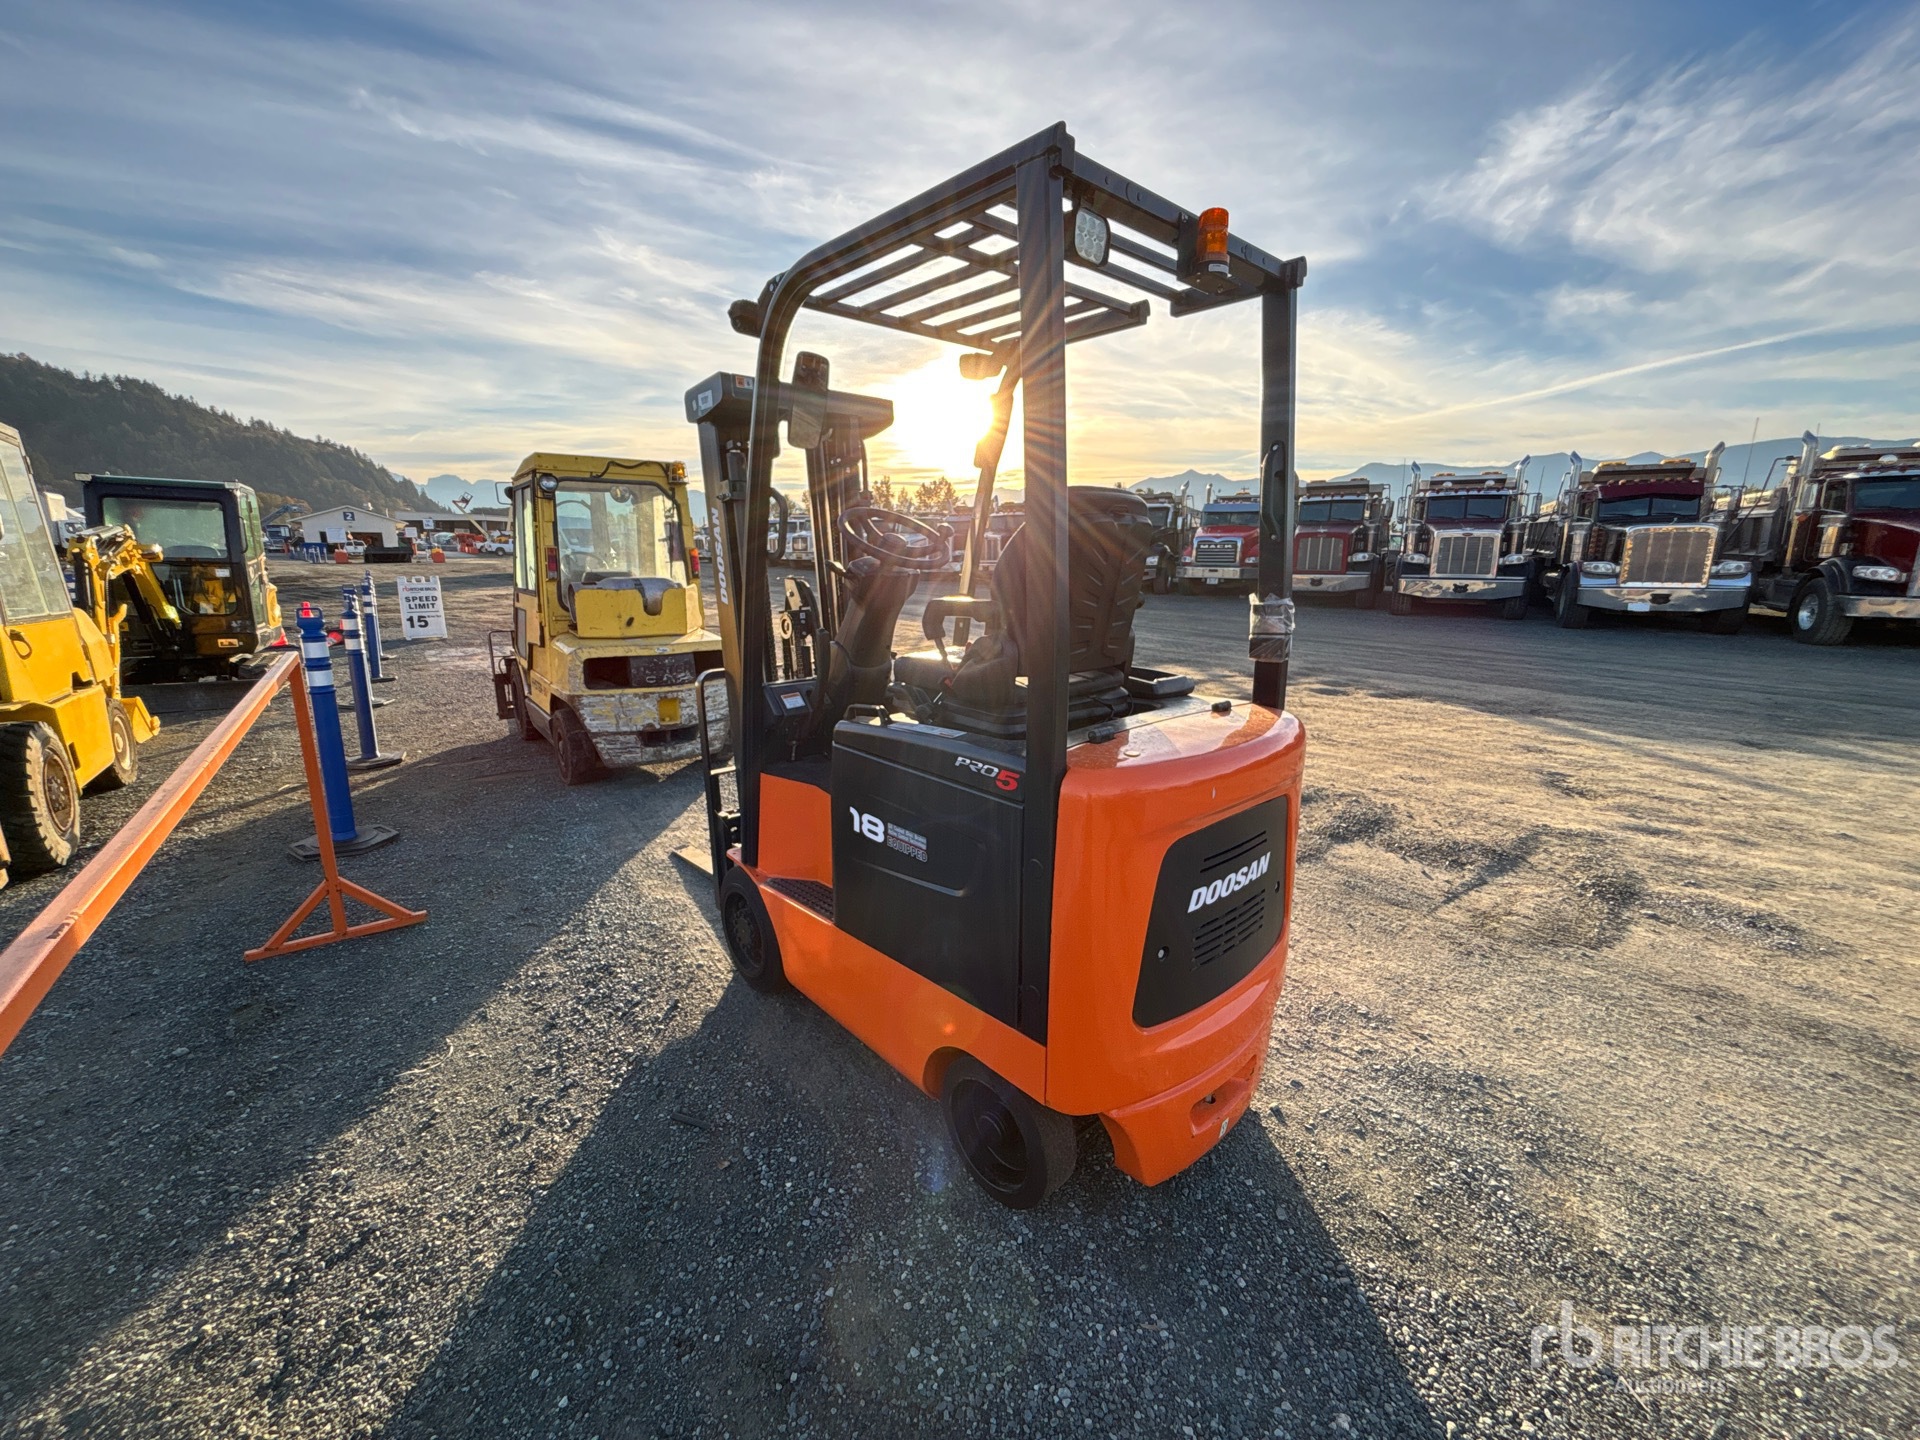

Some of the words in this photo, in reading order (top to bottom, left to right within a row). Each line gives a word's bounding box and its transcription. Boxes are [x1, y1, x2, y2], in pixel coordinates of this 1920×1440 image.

[711, 507, 728, 605] DOOSAN
[406, 615, 429, 629] 15
[849, 806, 885, 843] 18
[886, 835, 928, 863] EQUIPPED
[1187, 851, 1271, 914] DOOSAN
